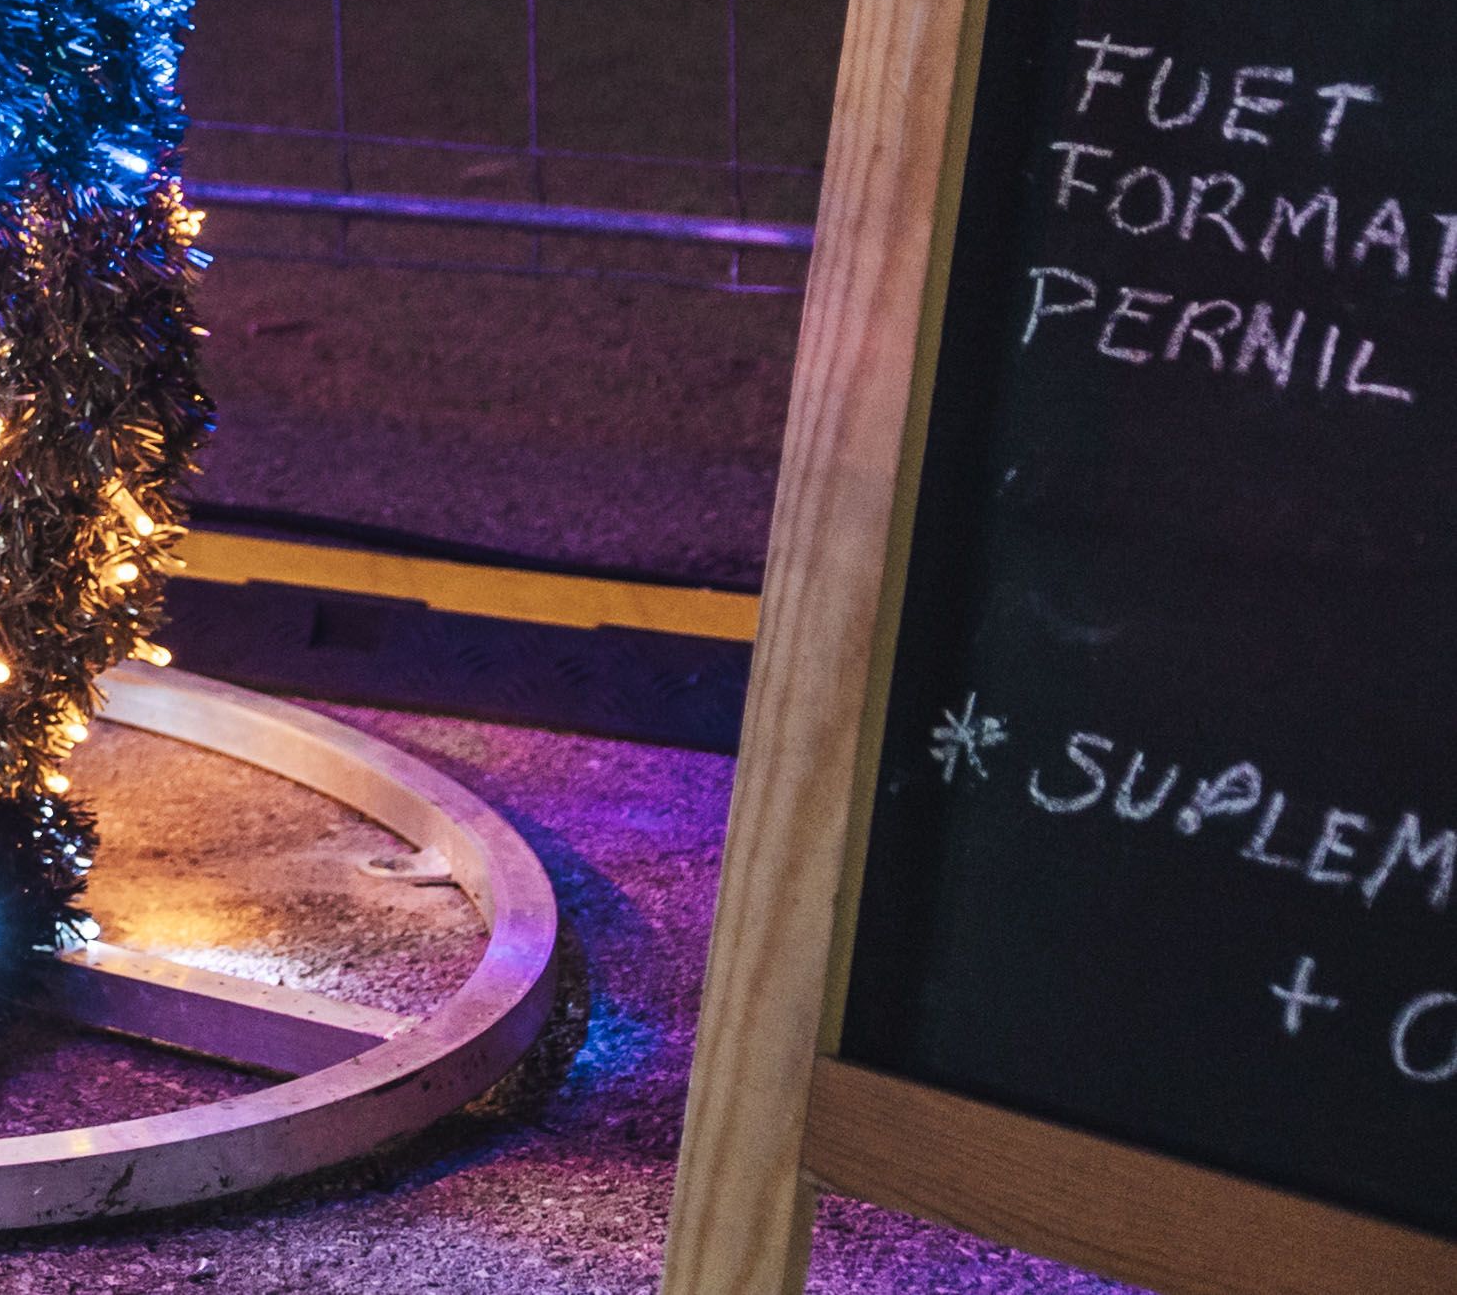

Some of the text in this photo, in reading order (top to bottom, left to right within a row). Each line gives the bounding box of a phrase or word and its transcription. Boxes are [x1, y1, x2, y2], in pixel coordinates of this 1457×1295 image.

[1076, 33, 1381, 151] FUET
[1022, 266, 1414, 403] PERNIL
[1029, 731, 1457, 907] SUPLEM
